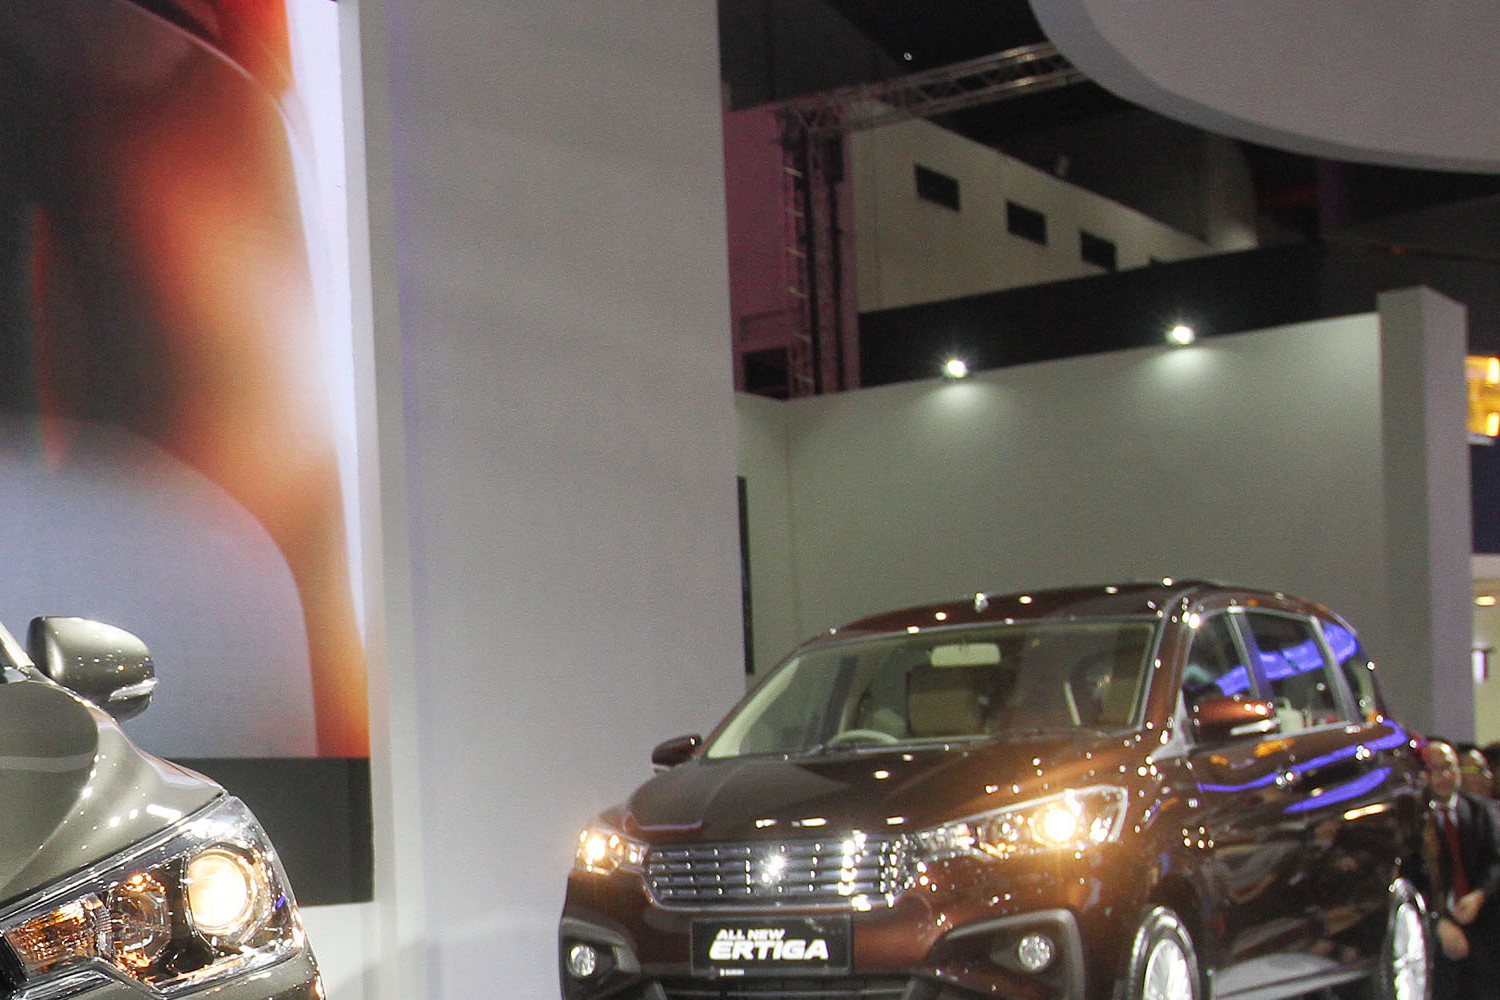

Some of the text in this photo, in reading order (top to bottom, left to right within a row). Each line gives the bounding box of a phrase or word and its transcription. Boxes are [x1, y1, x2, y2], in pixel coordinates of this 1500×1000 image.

[716, 928, 786, 940] ALL NEW
[708, 939, 830, 961] ERTIGA
